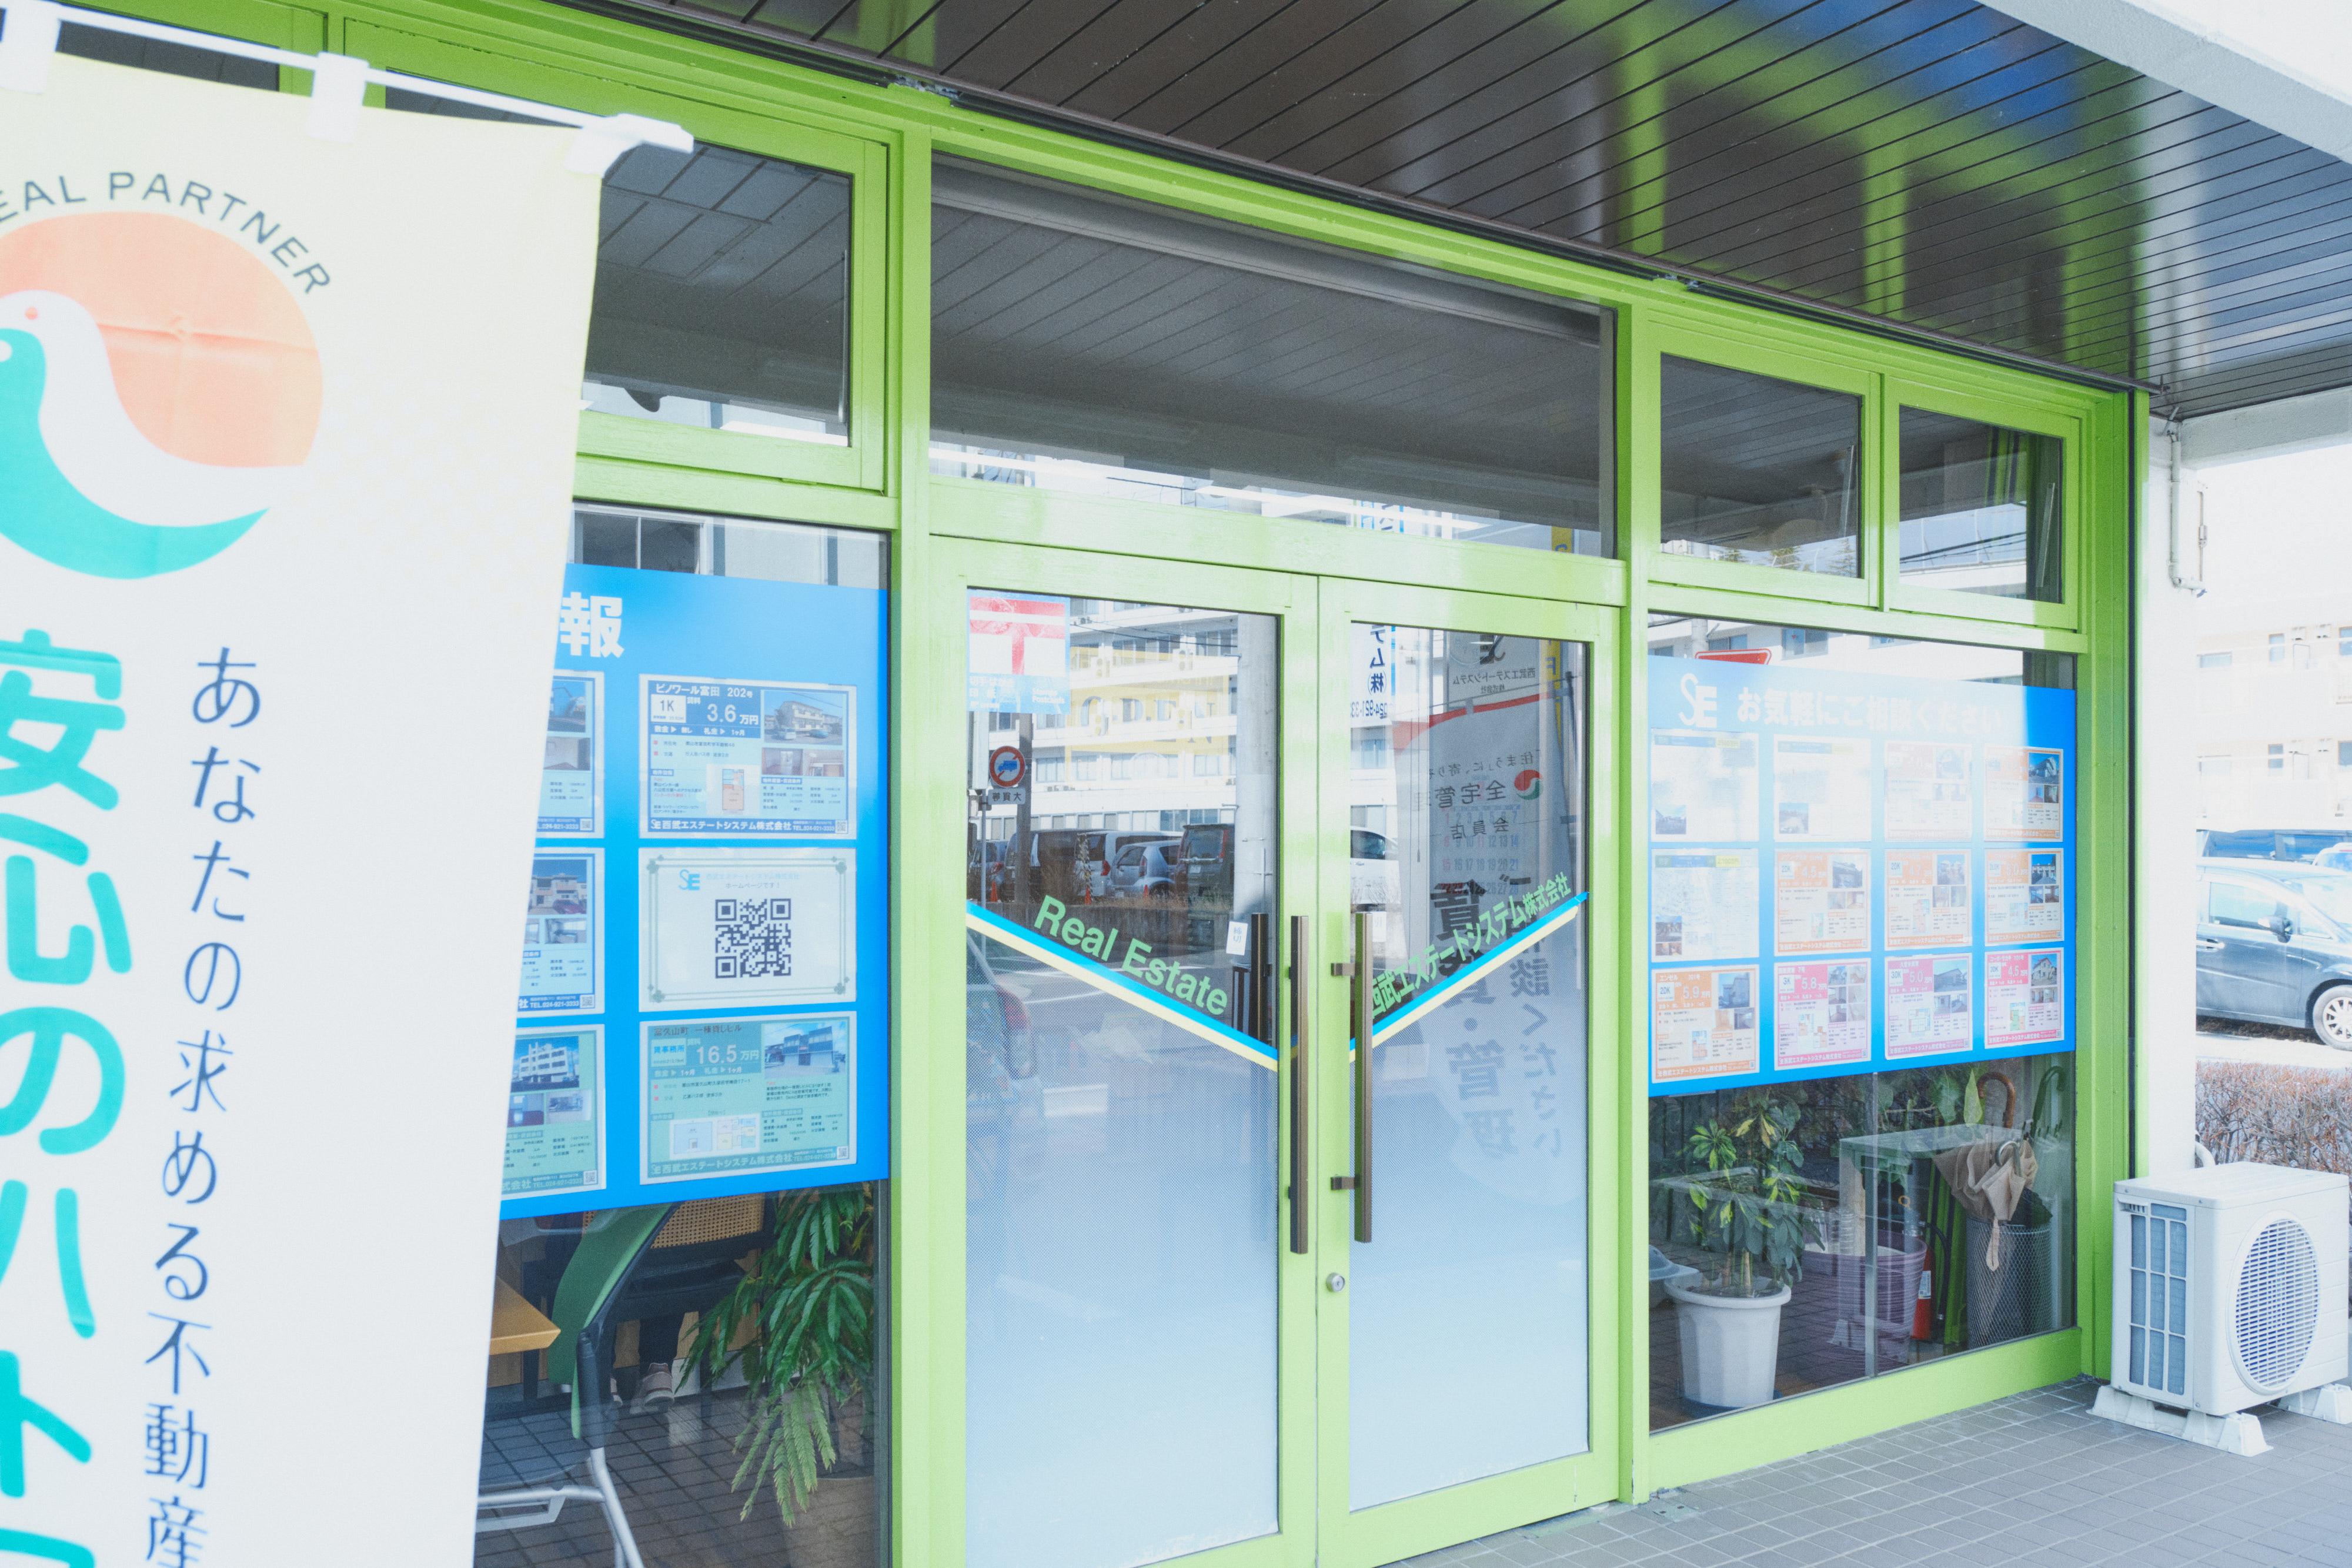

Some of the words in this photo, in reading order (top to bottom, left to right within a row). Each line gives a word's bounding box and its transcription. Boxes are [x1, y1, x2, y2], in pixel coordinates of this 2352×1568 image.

[109, 171, 331, 295] PARTNER
[660, 699, 674, 712] 1K
[706, 703, 736, 723] 3.6
[1738, 686, 2002, 735] お気軽にご相談ください
[1034, 894, 1119, 961] Real
[1121, 938, 1228, 1015] Estate
[1372, 871, 1572, 1019] 西武エステートシステム株式会社
[1802, 977, 1817, 990] 5.8
[1909, 971, 1924, 982] 5.0
[1683, 985, 1700, 999] 5.9
[696, 1044, 737, 1065] 16.5
[740, 1049, 759, 1061] 万円
[145, 647, 261, 1568] あなたの求める不動産
[662, 1154, 793, 1174] 西武エステートシステム株式会社
